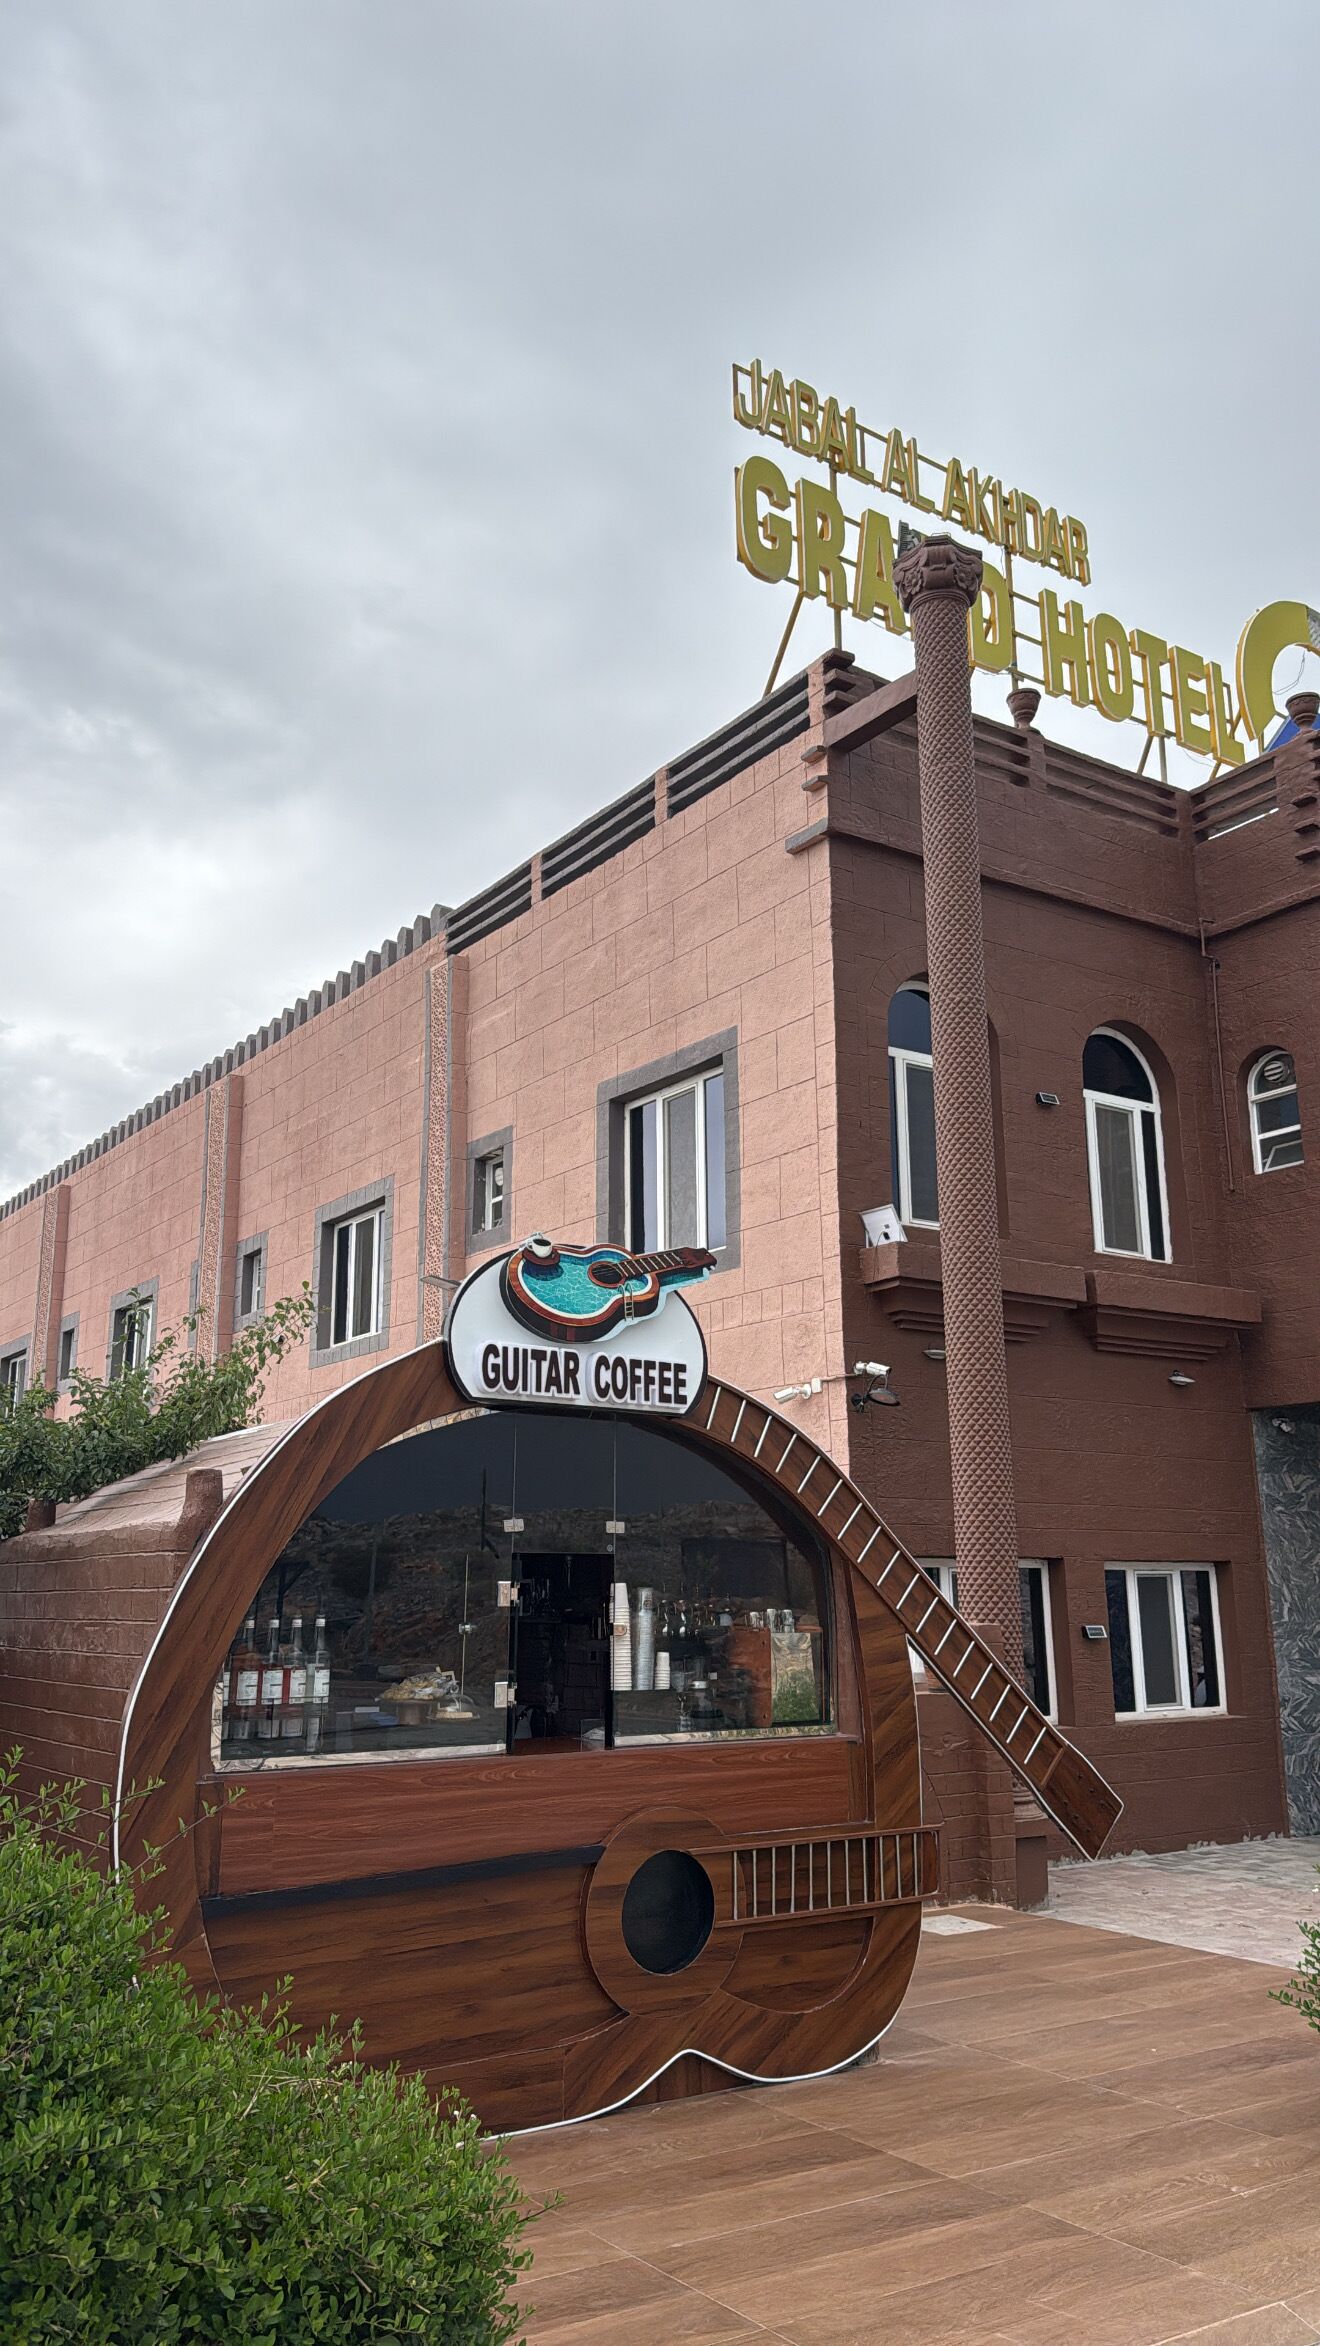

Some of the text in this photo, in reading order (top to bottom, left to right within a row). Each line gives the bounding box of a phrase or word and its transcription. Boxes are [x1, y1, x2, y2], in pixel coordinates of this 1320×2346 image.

[735, 358, 1091, 587] JABAL AL AKHDAR
[736, 456, 1246, 767] GRAD HOTEL
[481, 1343, 688, 1405] GUITAR COFFEE
